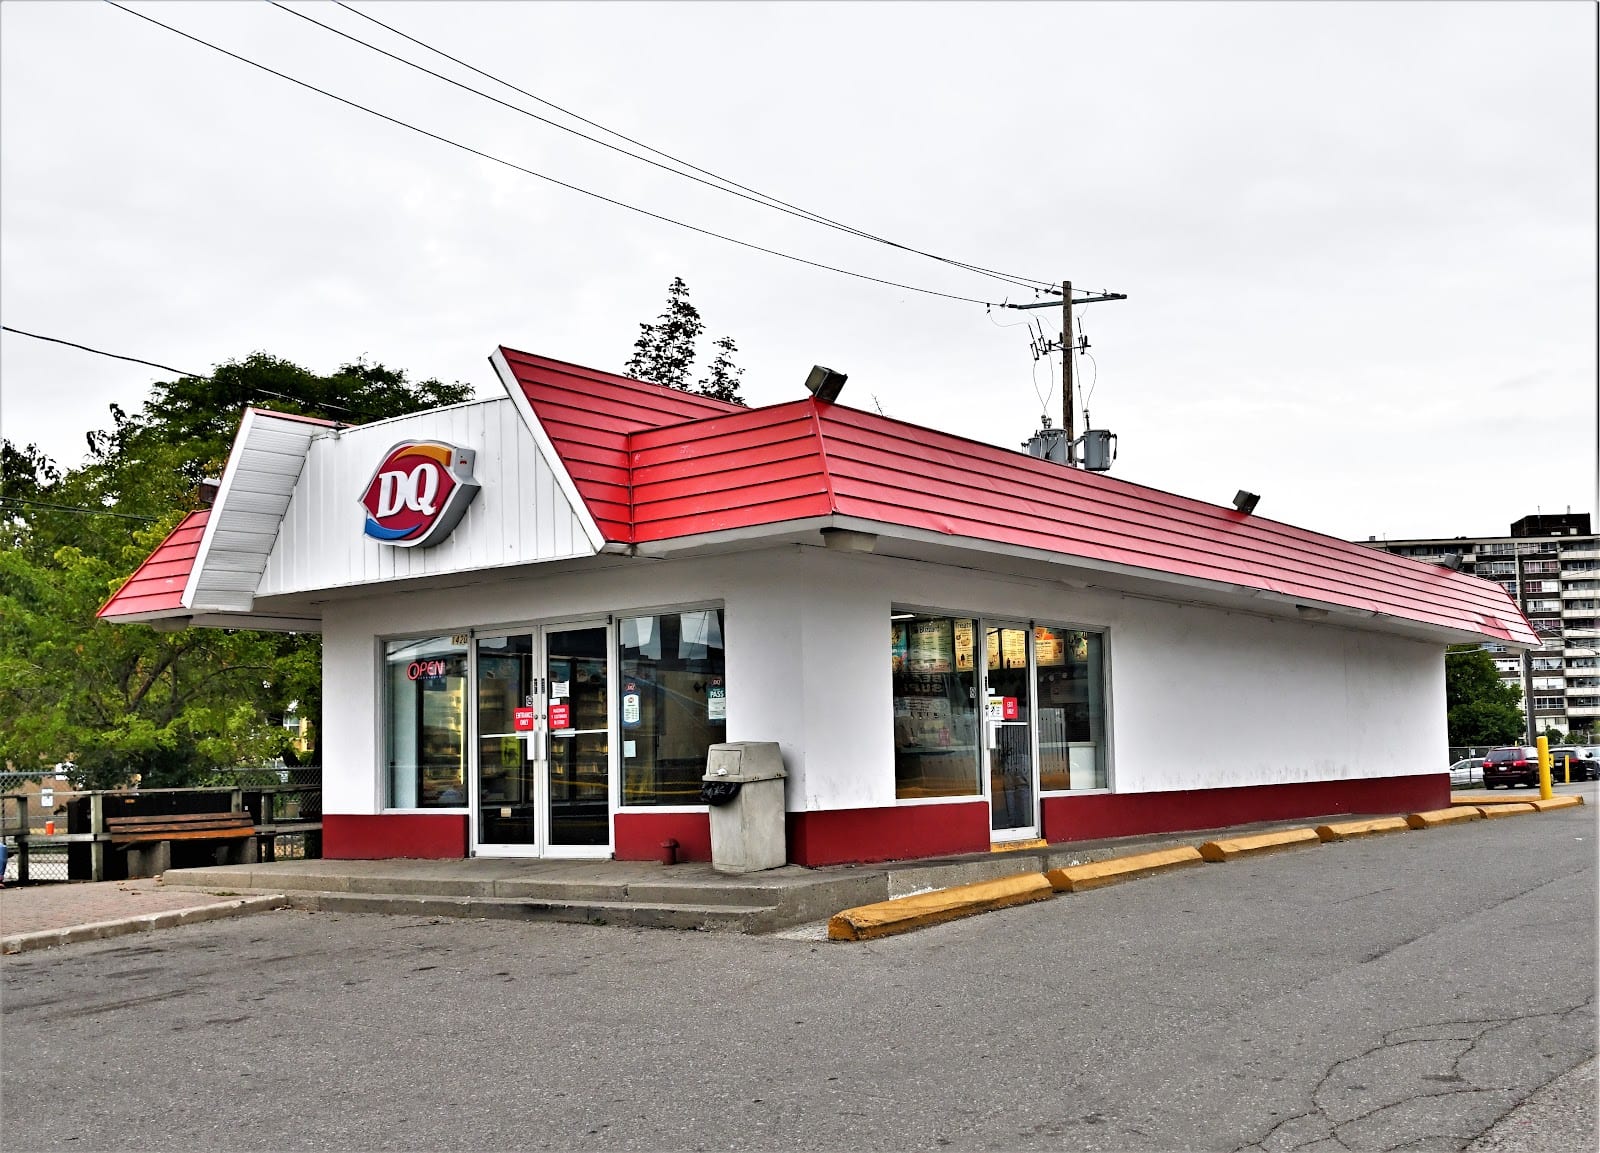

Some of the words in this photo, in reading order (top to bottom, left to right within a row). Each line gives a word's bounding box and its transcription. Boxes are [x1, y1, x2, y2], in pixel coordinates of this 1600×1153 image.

[376, 463, 439, 518] DQ
[407, 661, 446, 680] OPEN
[710, 690, 724, 698] PASS
